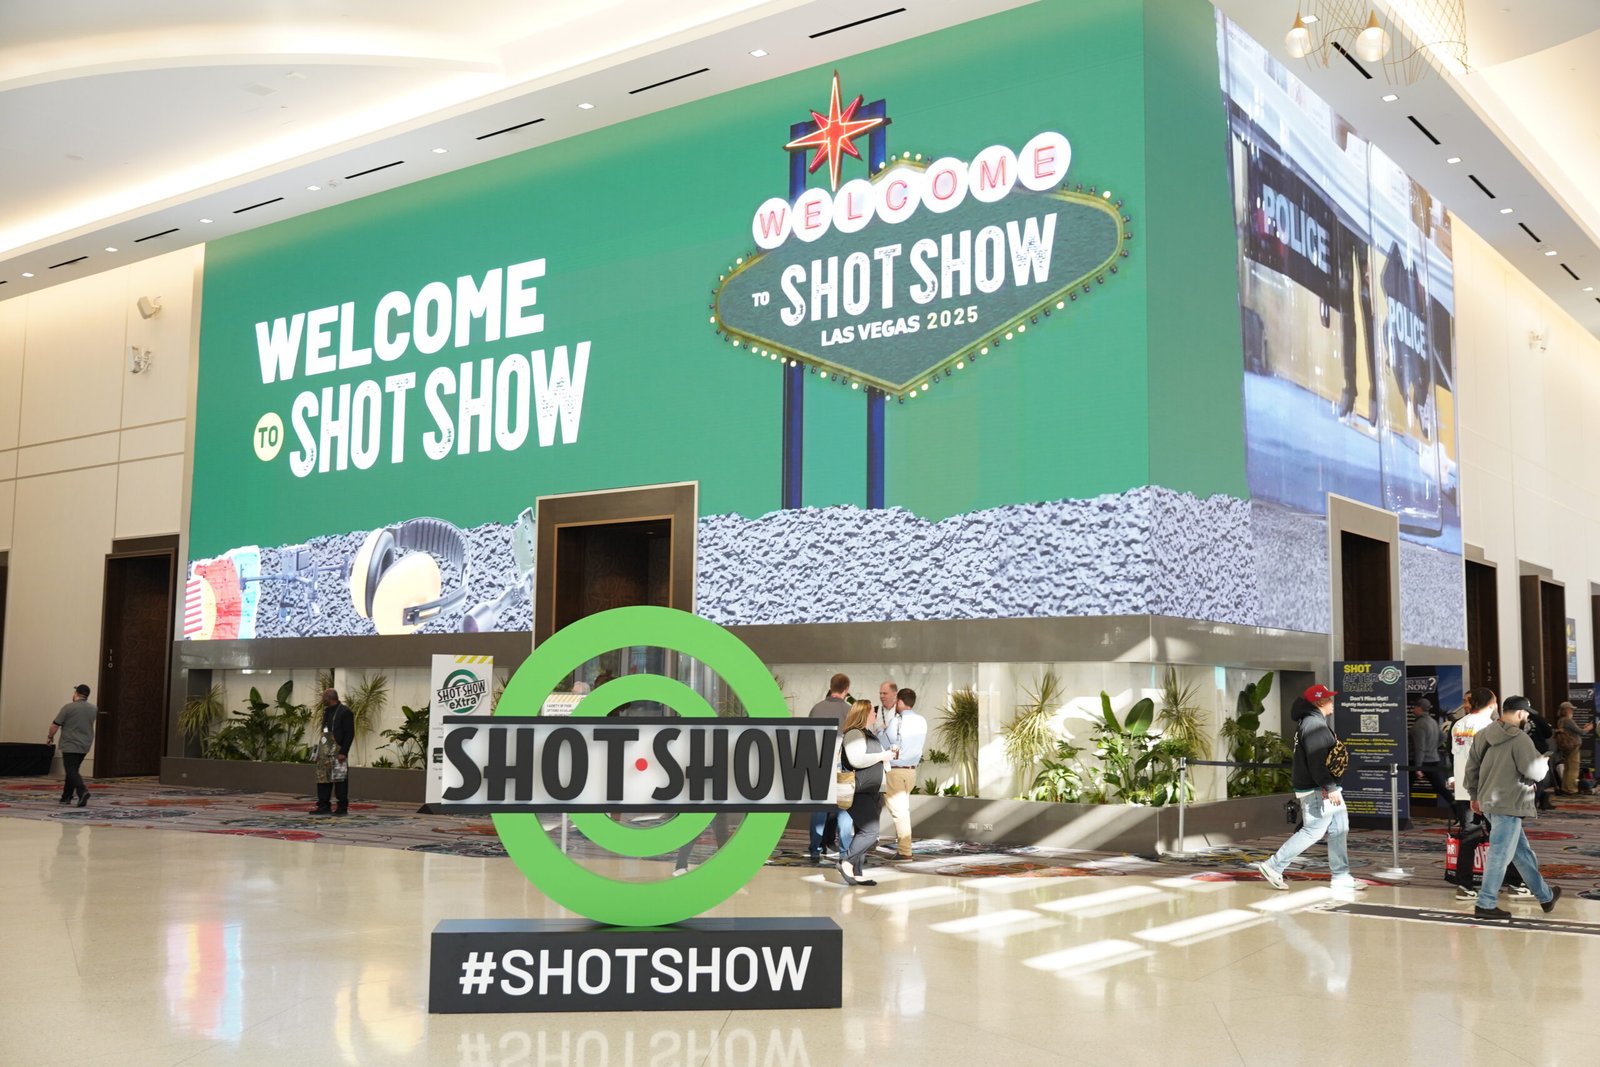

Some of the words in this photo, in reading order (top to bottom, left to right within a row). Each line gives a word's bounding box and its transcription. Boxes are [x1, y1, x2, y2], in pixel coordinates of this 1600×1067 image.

[759, 145, 1056, 240] WELCOME
[1262, 184, 1331, 274] POLICE
[751, 291, 770, 307] TO
[780, 243, 902, 327] SHOT
[909, 212, 1057, 305] SHOW
[255, 258, 547, 385] WELCOME
[821, 324, 855, 347] LAS
[858, 314, 920, 341] VEGAS
[926, 305, 979, 330] 2025
[1386, 294, 1427, 359] POLICE
[258, 425, 279, 450] TO
[288, 371, 416, 478] SHOT
[424, 341, 592, 462] SHOW
[1343, 663, 1371, 673] SHOT
[1343, 672, 1379, 683] AFTER
[1343, 682, 1374, 692] DARK
[449, 696, 477, 710] eXtra
[442, 727, 639, 802] SHOT
[652, 726, 839, 802] SHOW
[459, 946, 813, 996] #SHOTSHOW
